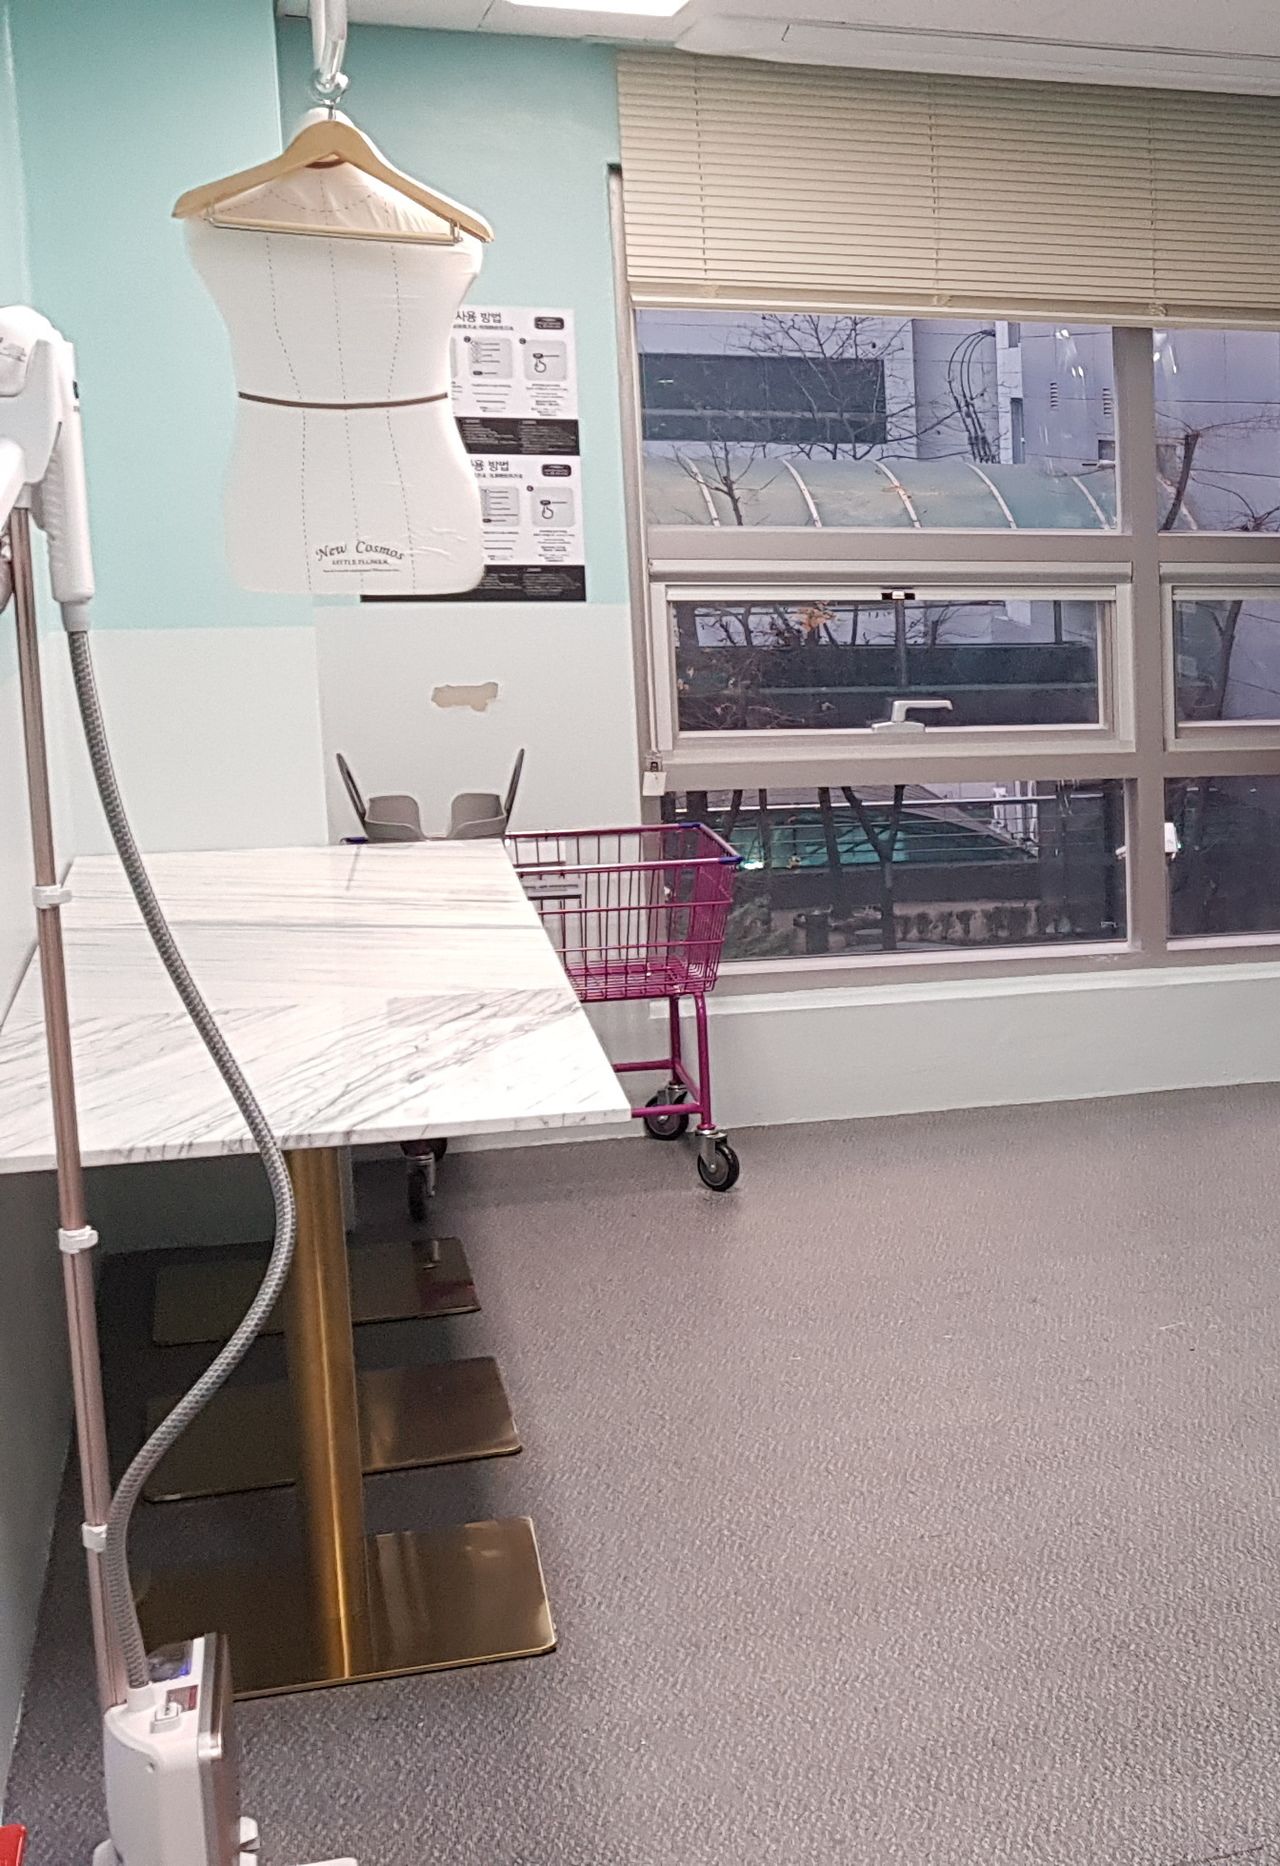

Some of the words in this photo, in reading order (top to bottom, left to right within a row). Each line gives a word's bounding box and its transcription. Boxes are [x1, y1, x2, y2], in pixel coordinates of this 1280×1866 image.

[480, 312, 502, 323] 방법
[488, 460, 509, 472] 방법
[315, 544, 347, 562] New
[355, 540, 405, 560] Cosmos
